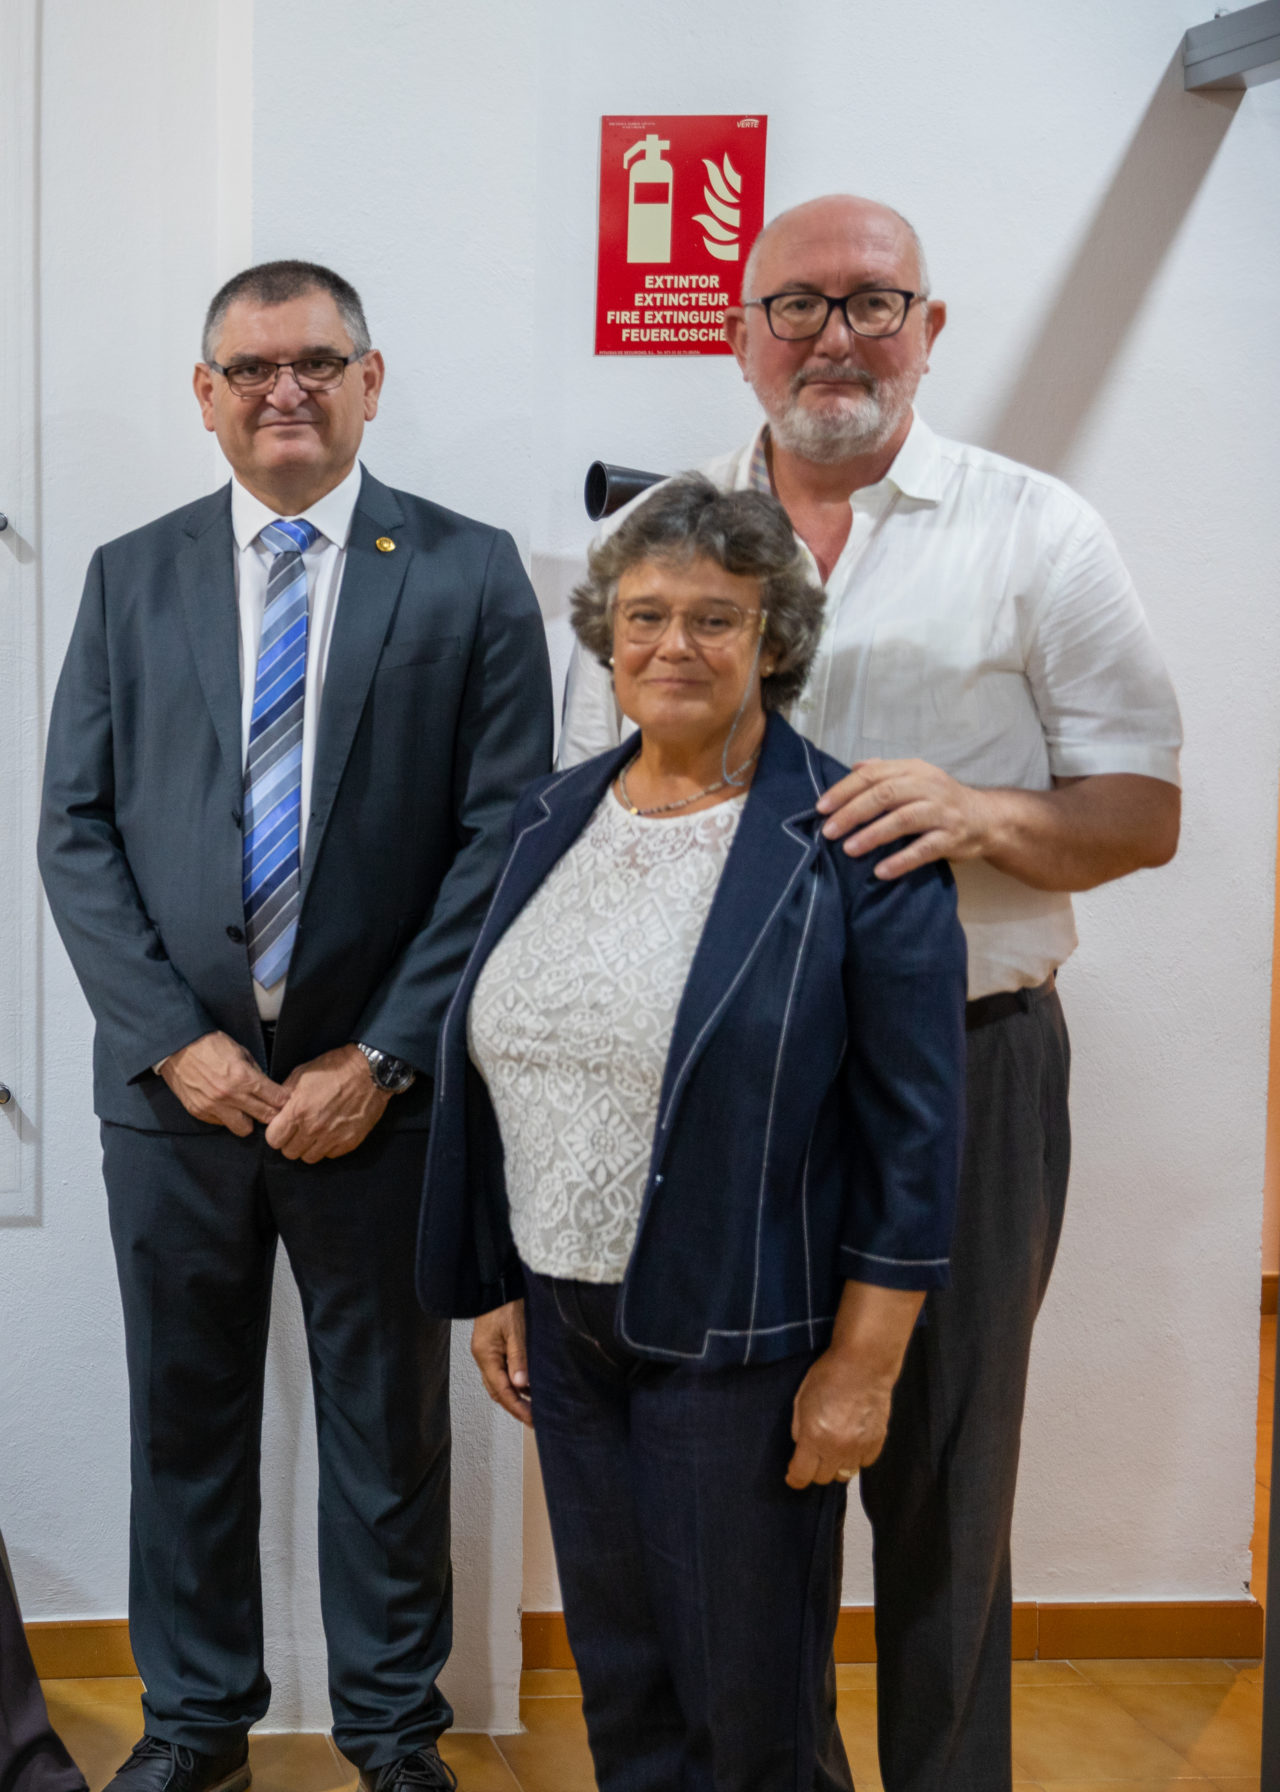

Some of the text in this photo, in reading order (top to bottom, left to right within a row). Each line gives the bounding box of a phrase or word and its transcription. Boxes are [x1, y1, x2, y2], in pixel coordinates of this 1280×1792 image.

[644, 275, 720, 289] EXTINTOR
[634, 293, 729, 306] EXTINCTEUR
[606, 311, 640, 324] FIRE
